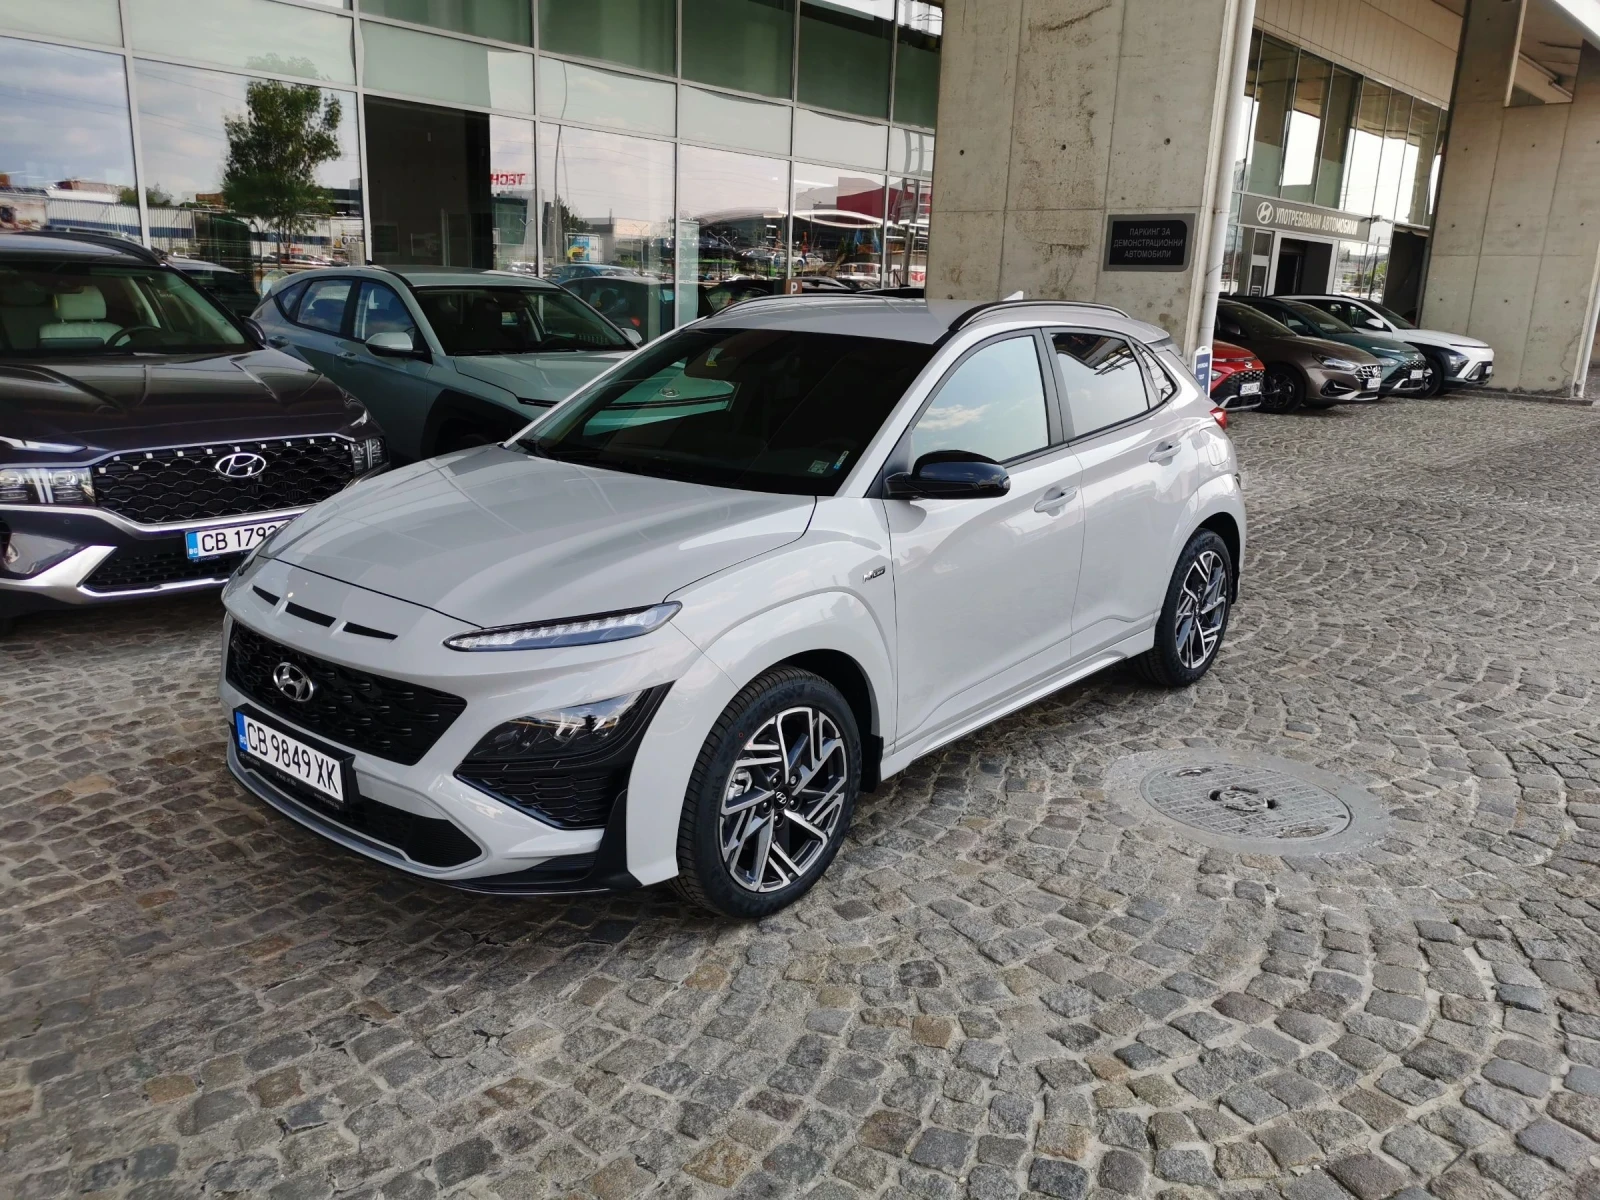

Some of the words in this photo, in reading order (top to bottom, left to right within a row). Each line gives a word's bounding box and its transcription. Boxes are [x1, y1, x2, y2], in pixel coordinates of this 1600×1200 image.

[1275, 207, 1321, 229] УПОТРЕБЯВАНИ
[1321, 215, 1359, 235] АВТОМОБИЛИ
[1129, 228, 1160, 236] ПАРКИНГ
[1161, 227, 1171, 236] ЗА
[1113, 238, 1183, 248] ДЕМОНСТРАЦИОННИ
[1124, 250, 1172, 258] АВТОМОБИЛИ
[790, 281, 798, 294] P
[201, 532, 228, 552] CB
[247, 722, 269, 757] CB
[270, 733, 312, 779] 9849
[314, 753, 339, 795] XK
